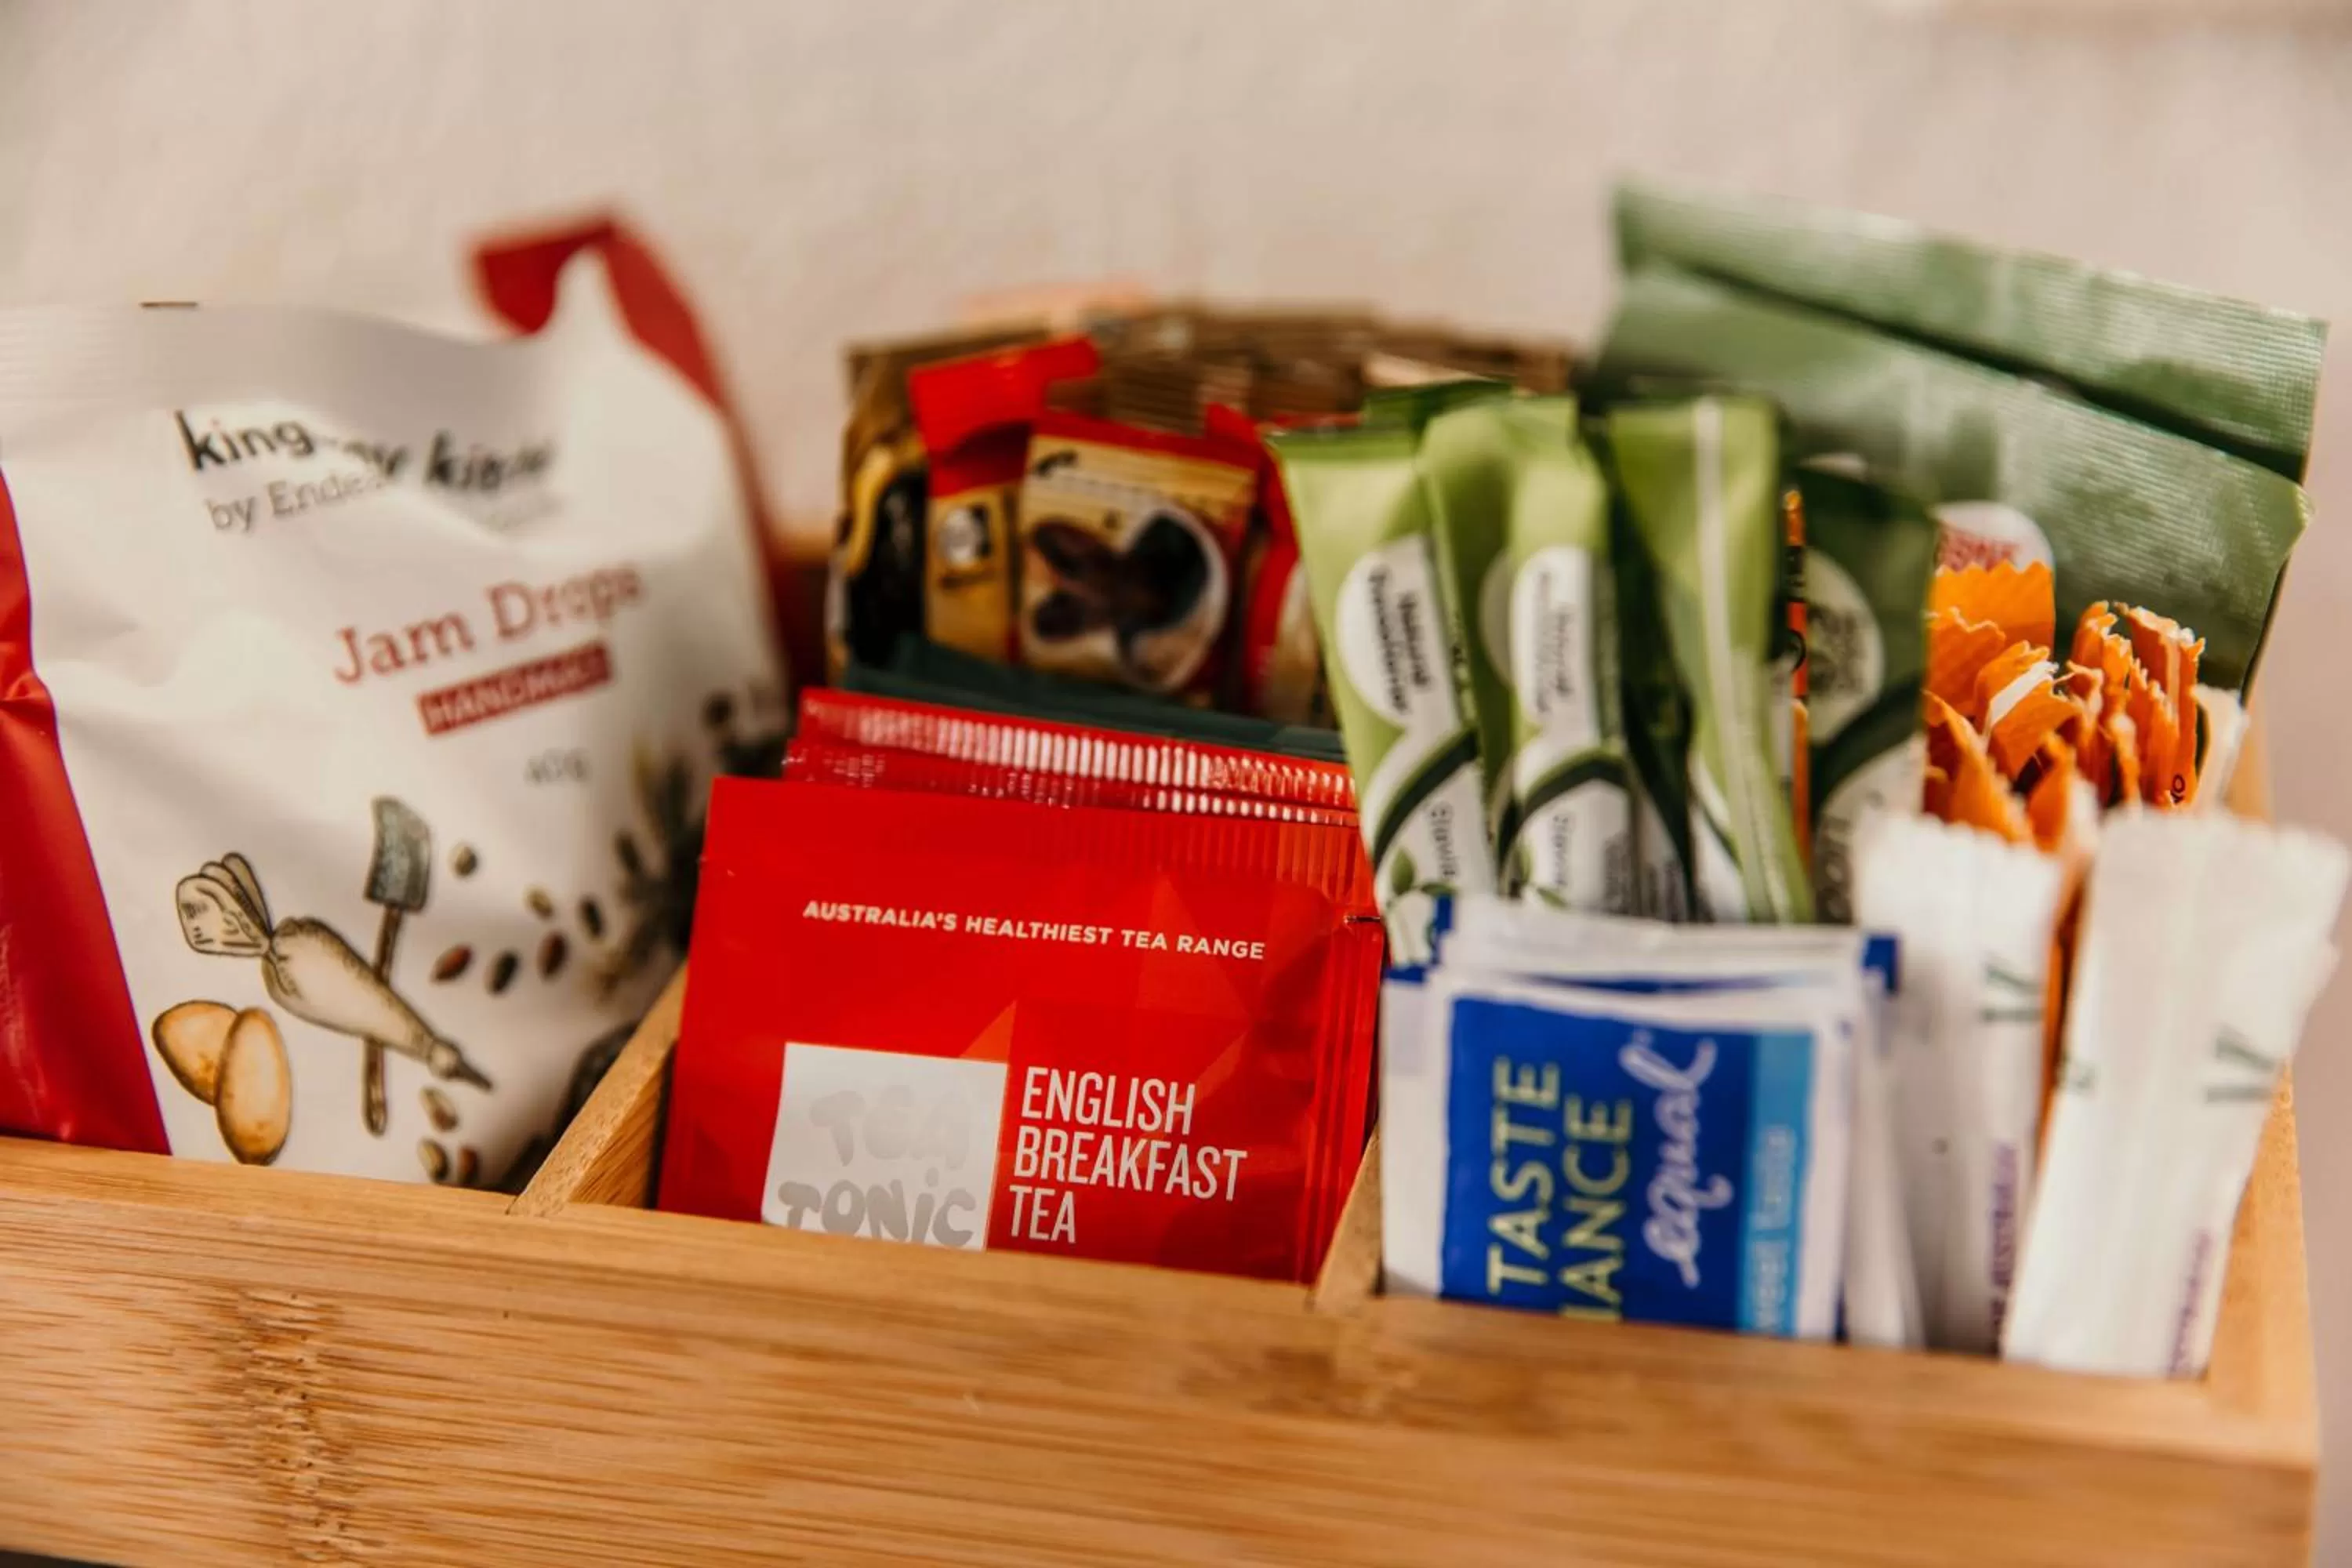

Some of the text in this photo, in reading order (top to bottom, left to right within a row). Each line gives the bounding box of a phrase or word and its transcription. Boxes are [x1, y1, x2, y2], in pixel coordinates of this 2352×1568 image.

[174, 410, 315, 472] king
[206, 495, 257, 533] by
[334, 612, 476, 685] Jam
[803, 900, 1265, 960] AUSTRALIA'S HEALTHIEST TEA RANGE
[1022, 1066, 1196, 1135] ENGLISH
[1014, 1125, 1248, 1201] BREAKFAST
[1486, 1055, 1561, 1294] TASTE
[1618, 1036, 1734, 1289] equal
[1010, 1185, 1076, 1244] TEA
